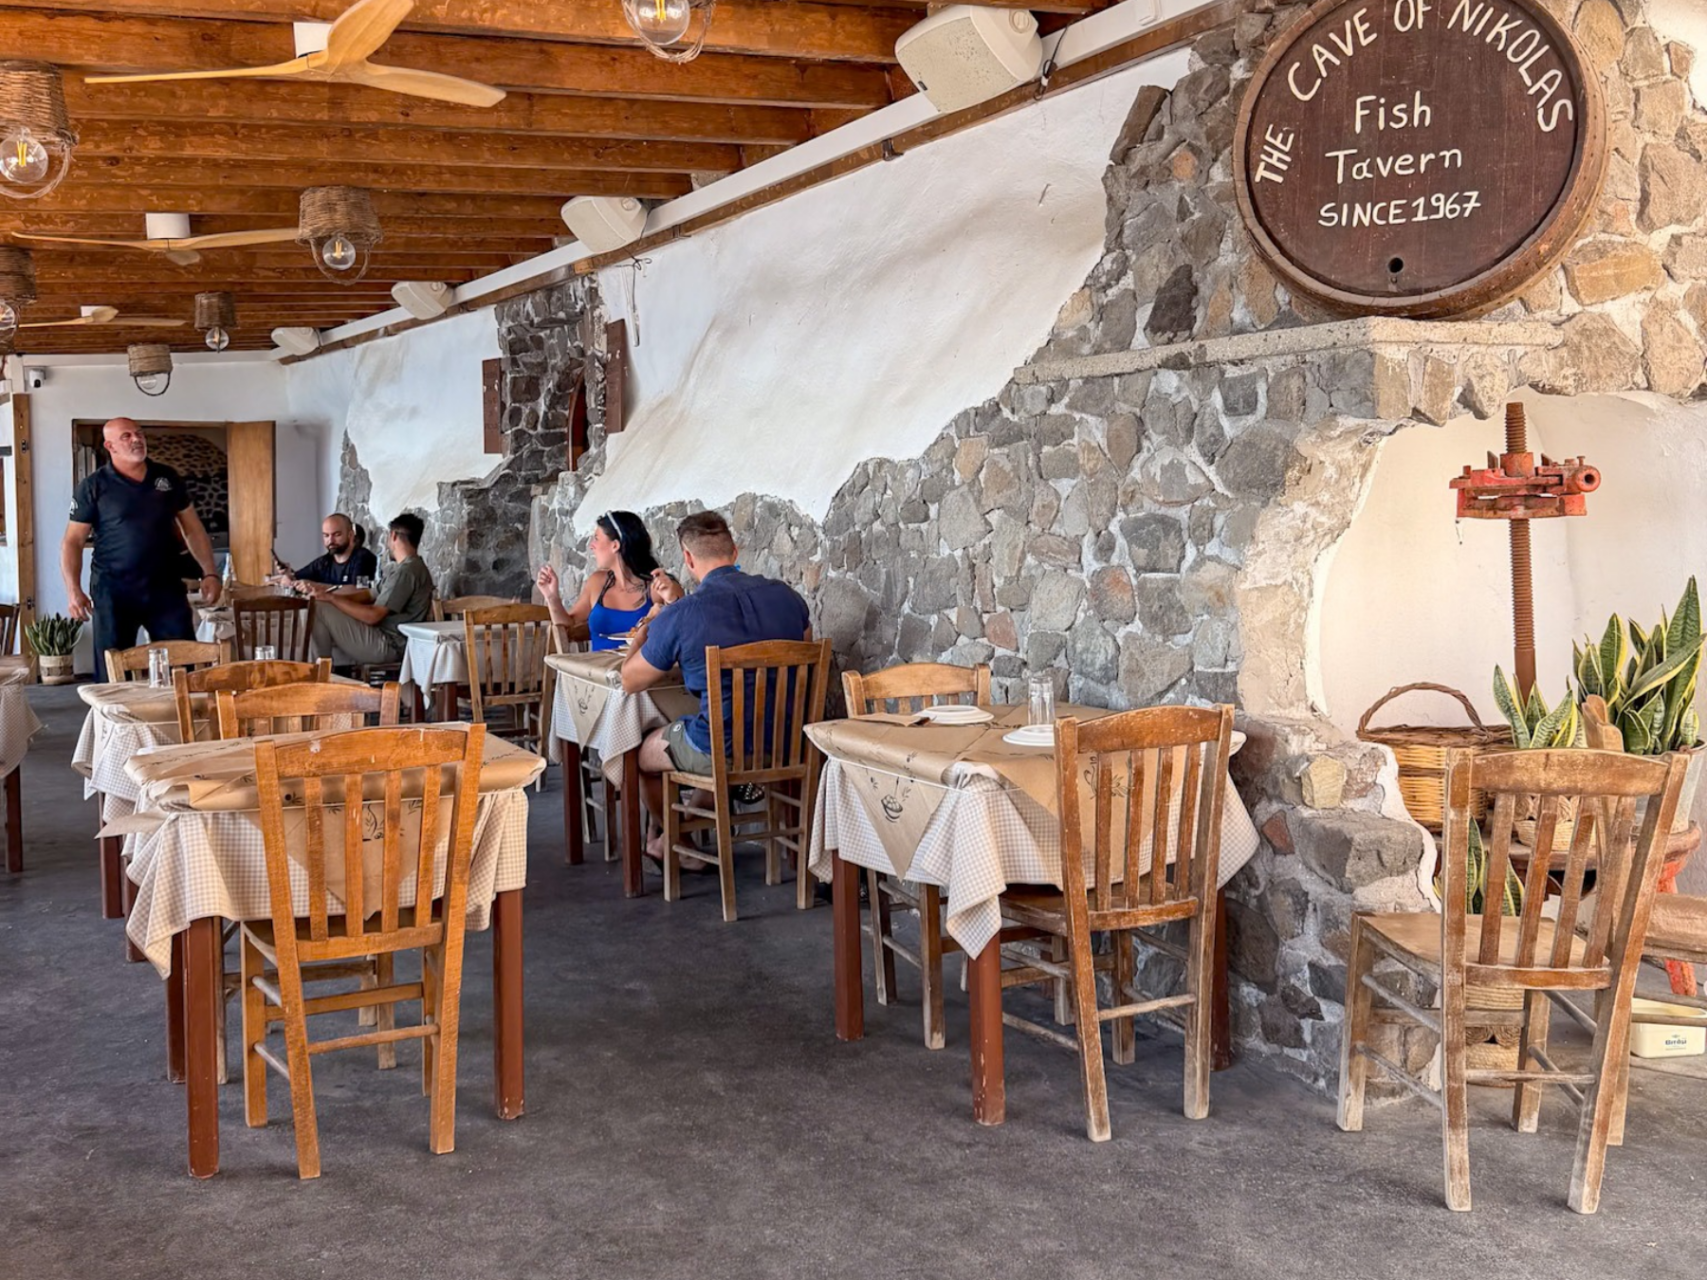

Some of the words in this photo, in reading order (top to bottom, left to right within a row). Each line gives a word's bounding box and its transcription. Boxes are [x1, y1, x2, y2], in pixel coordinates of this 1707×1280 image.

[1255, 124, 1294, 184] THE
[1287, 8, 1378, 101] CAVE
[1355, 91, 1431, 134] Fish
[1325, 148, 1462, 185] Tavern
